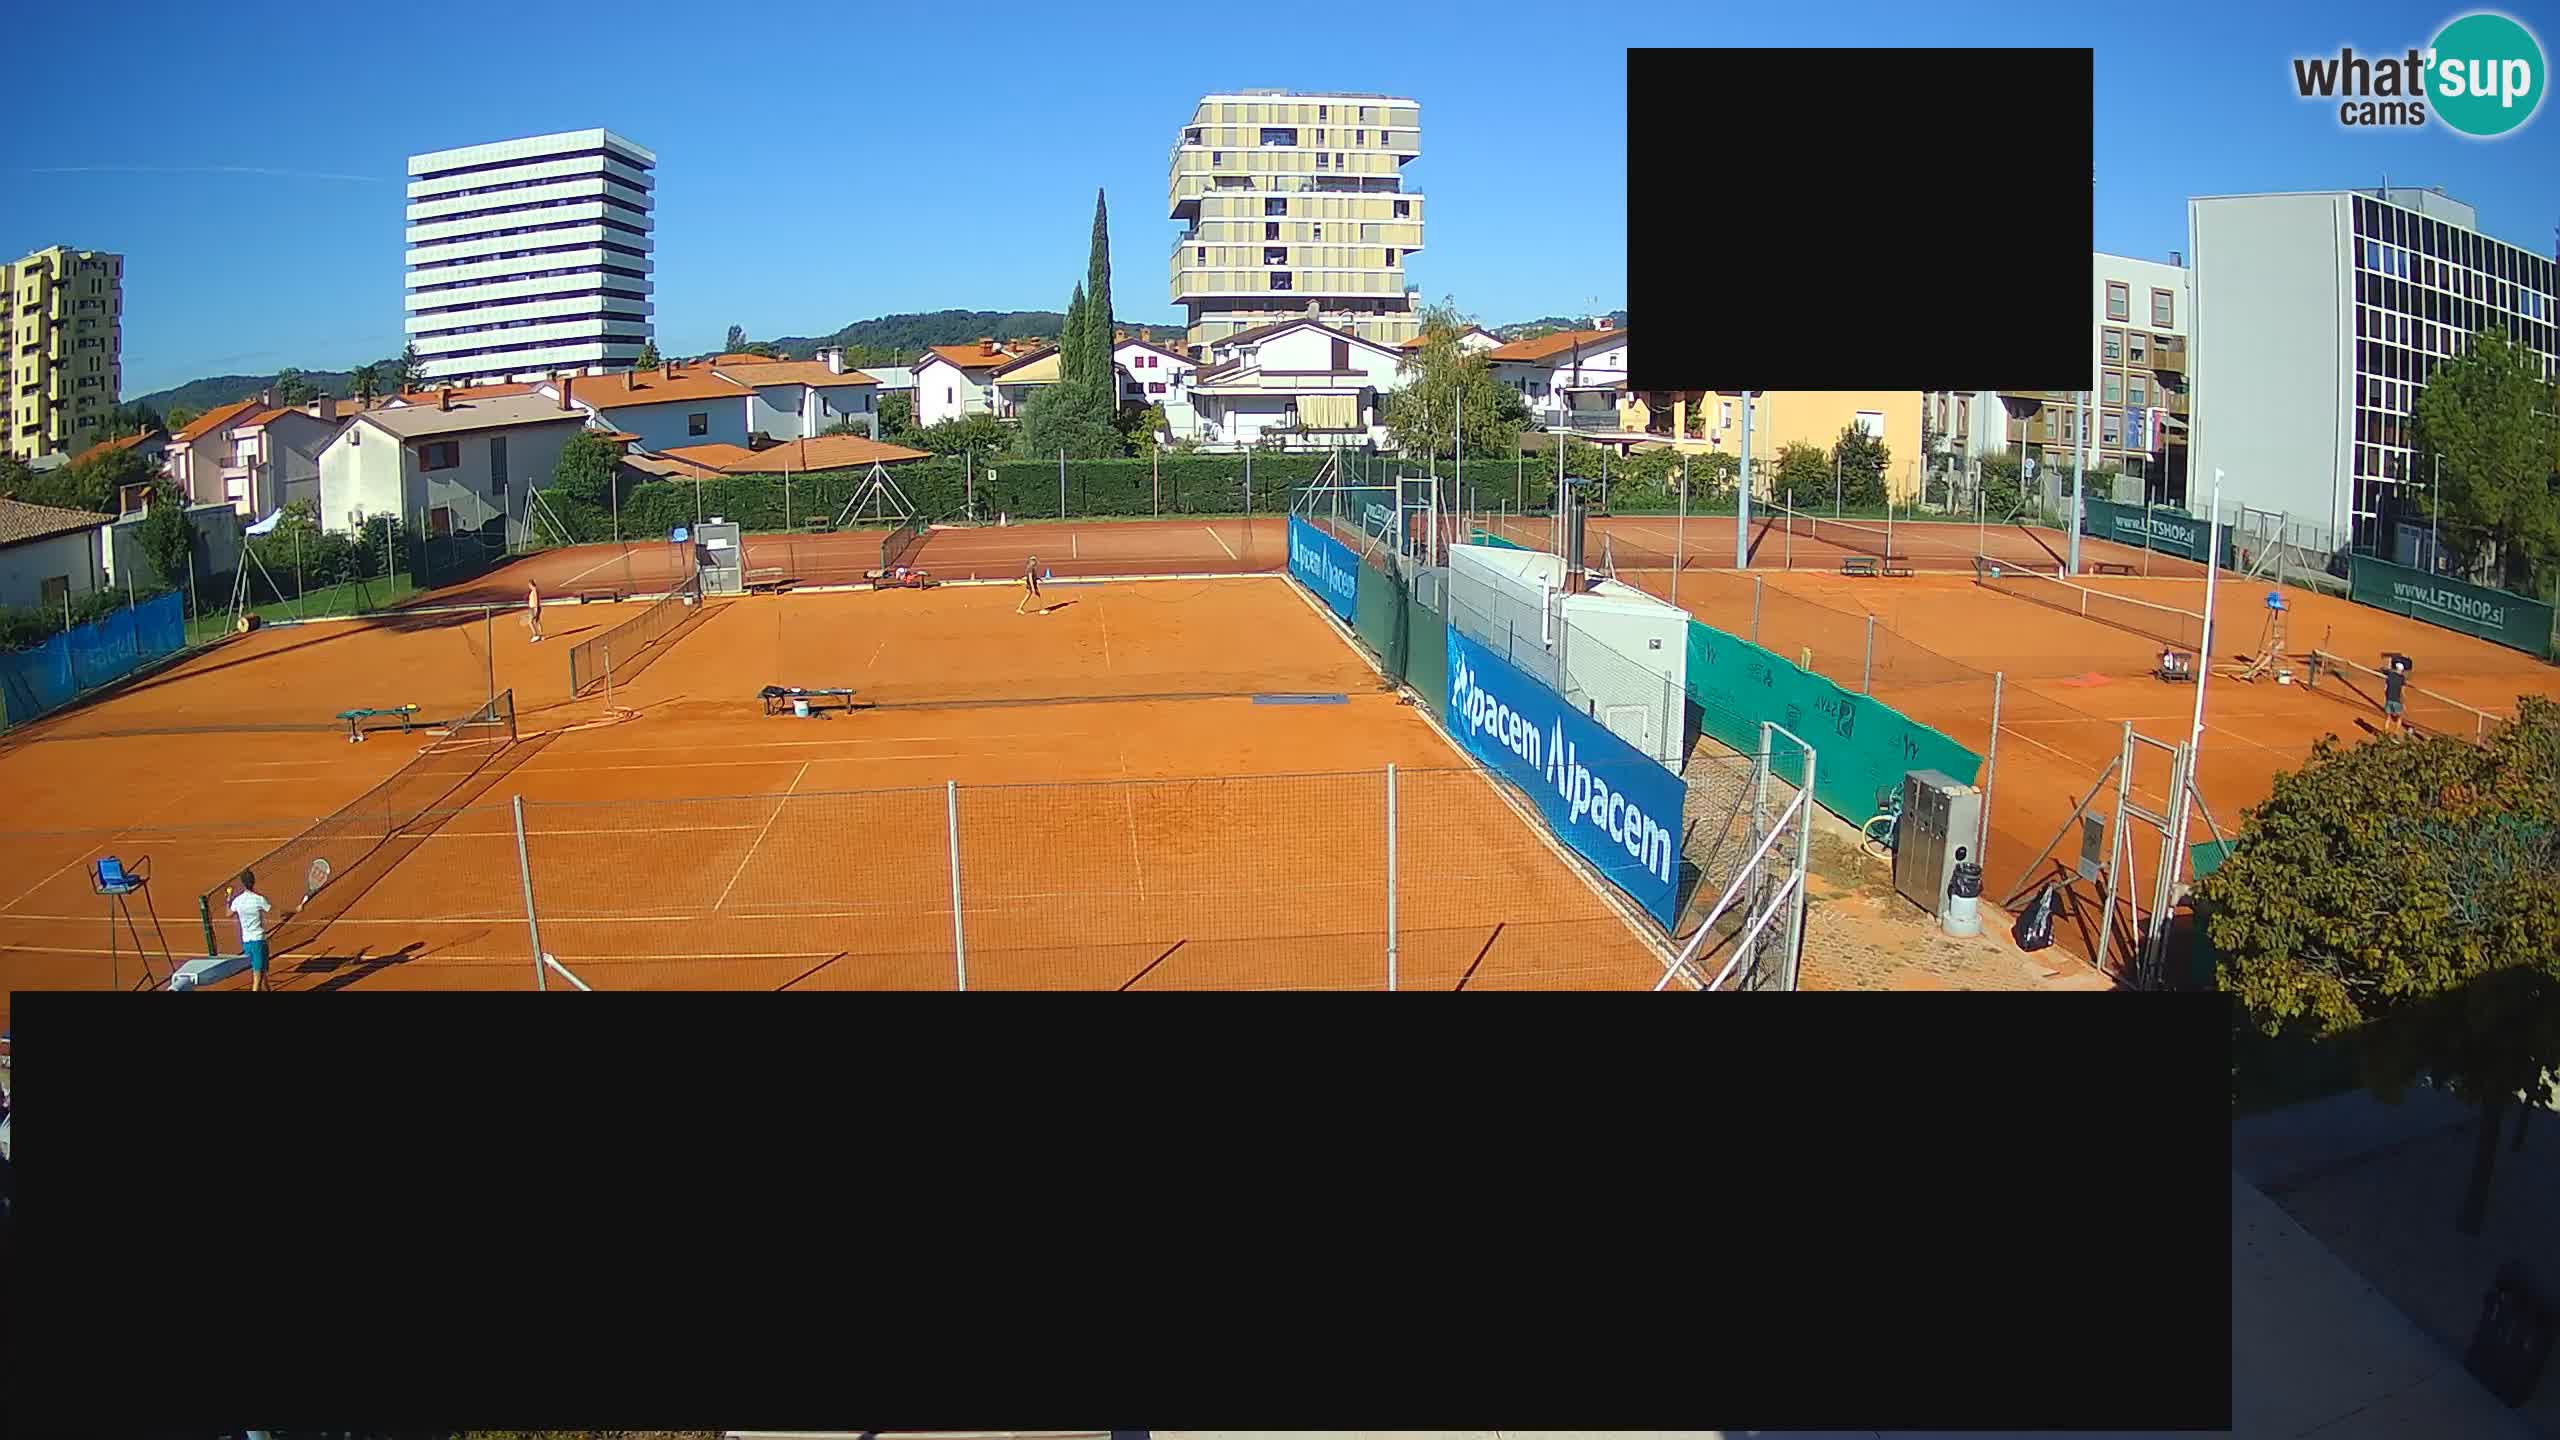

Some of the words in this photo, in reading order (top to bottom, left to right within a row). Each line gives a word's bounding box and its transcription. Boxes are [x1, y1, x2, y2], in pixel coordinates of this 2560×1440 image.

[2115, 516, 2194, 543] www.LTSHOP.si
[1452, 651, 1541, 770] Alpacem
[1547, 716, 1672, 884] Alpacem
